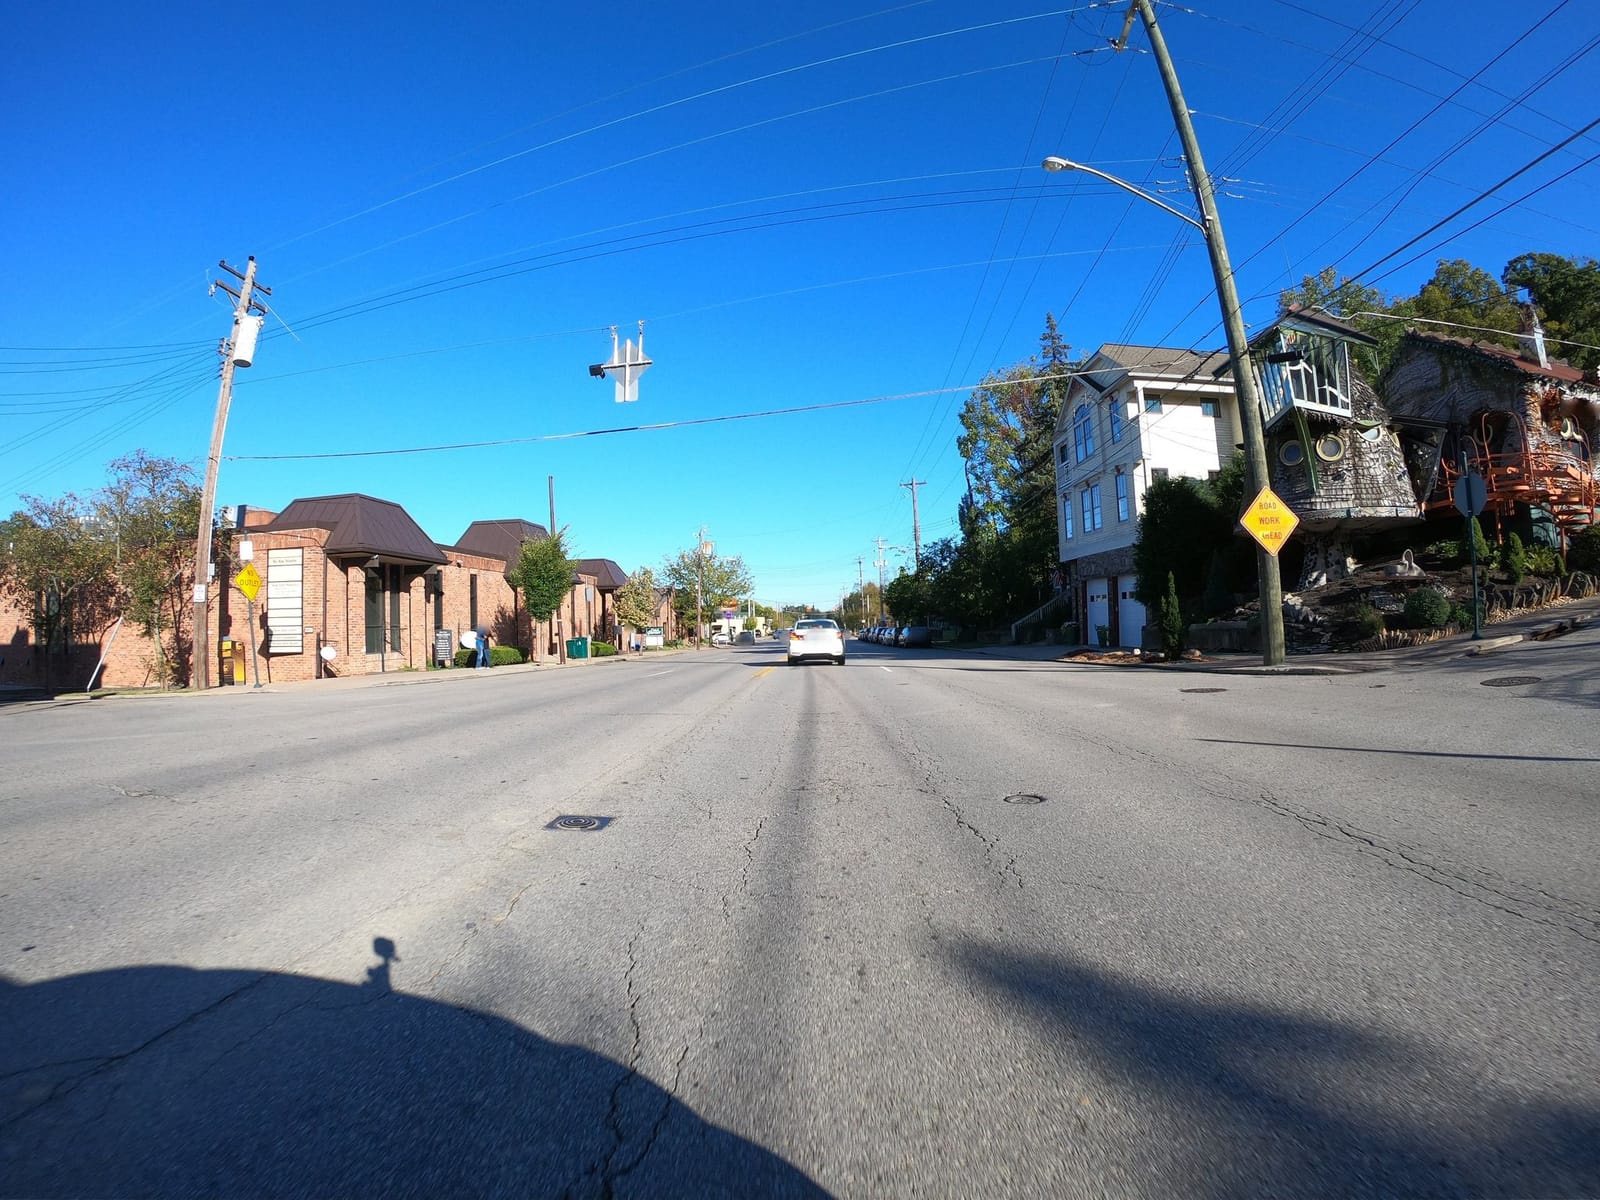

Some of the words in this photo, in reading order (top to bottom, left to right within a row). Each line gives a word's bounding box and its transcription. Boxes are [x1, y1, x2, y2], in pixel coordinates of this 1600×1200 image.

[1259, 502, 1277, 510] ROAD
[1259, 516, 1280, 525] WORK
[1262, 531, 1282, 540] AHEAD
[239, 578, 259, 587] OUTLET
